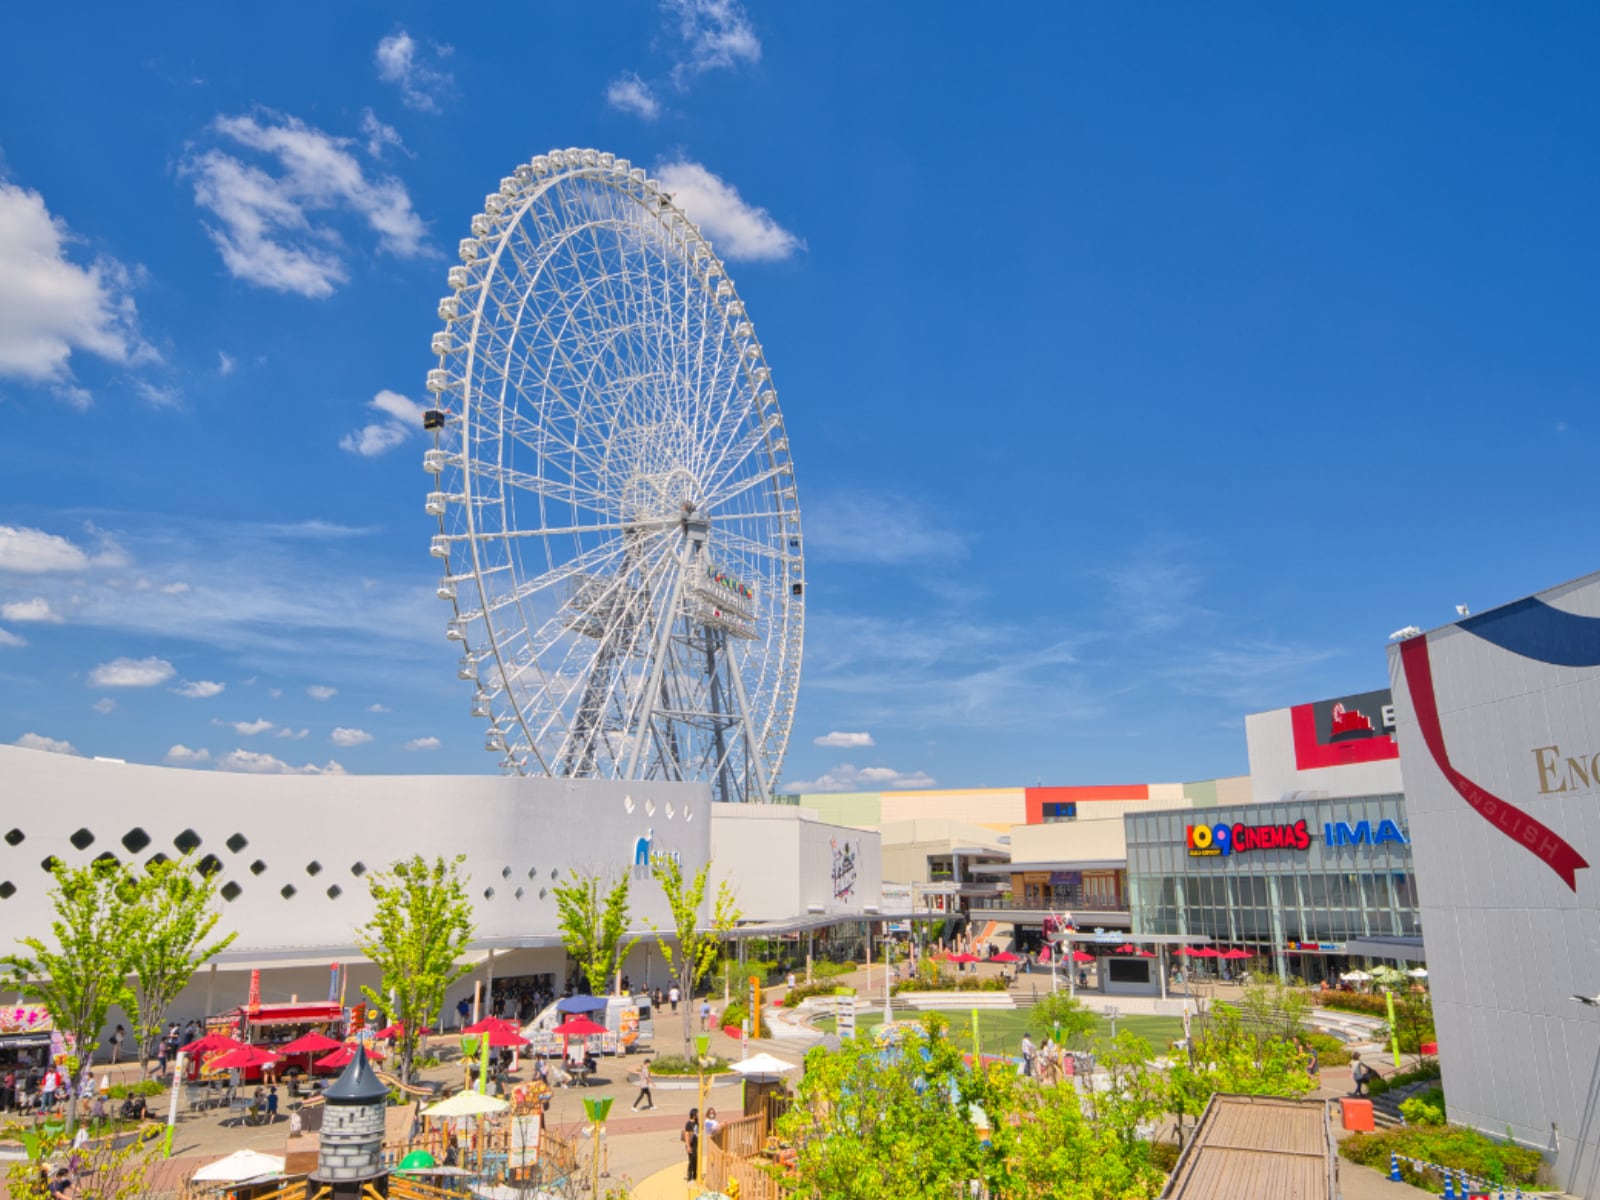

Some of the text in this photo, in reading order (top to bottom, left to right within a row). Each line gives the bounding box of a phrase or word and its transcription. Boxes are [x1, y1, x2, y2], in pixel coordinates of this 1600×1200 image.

[1232, 818, 1310, 853] CINEMAS
[1324, 818, 1411, 847] IMA
[1459, 780, 1560, 860] ENGLISH
